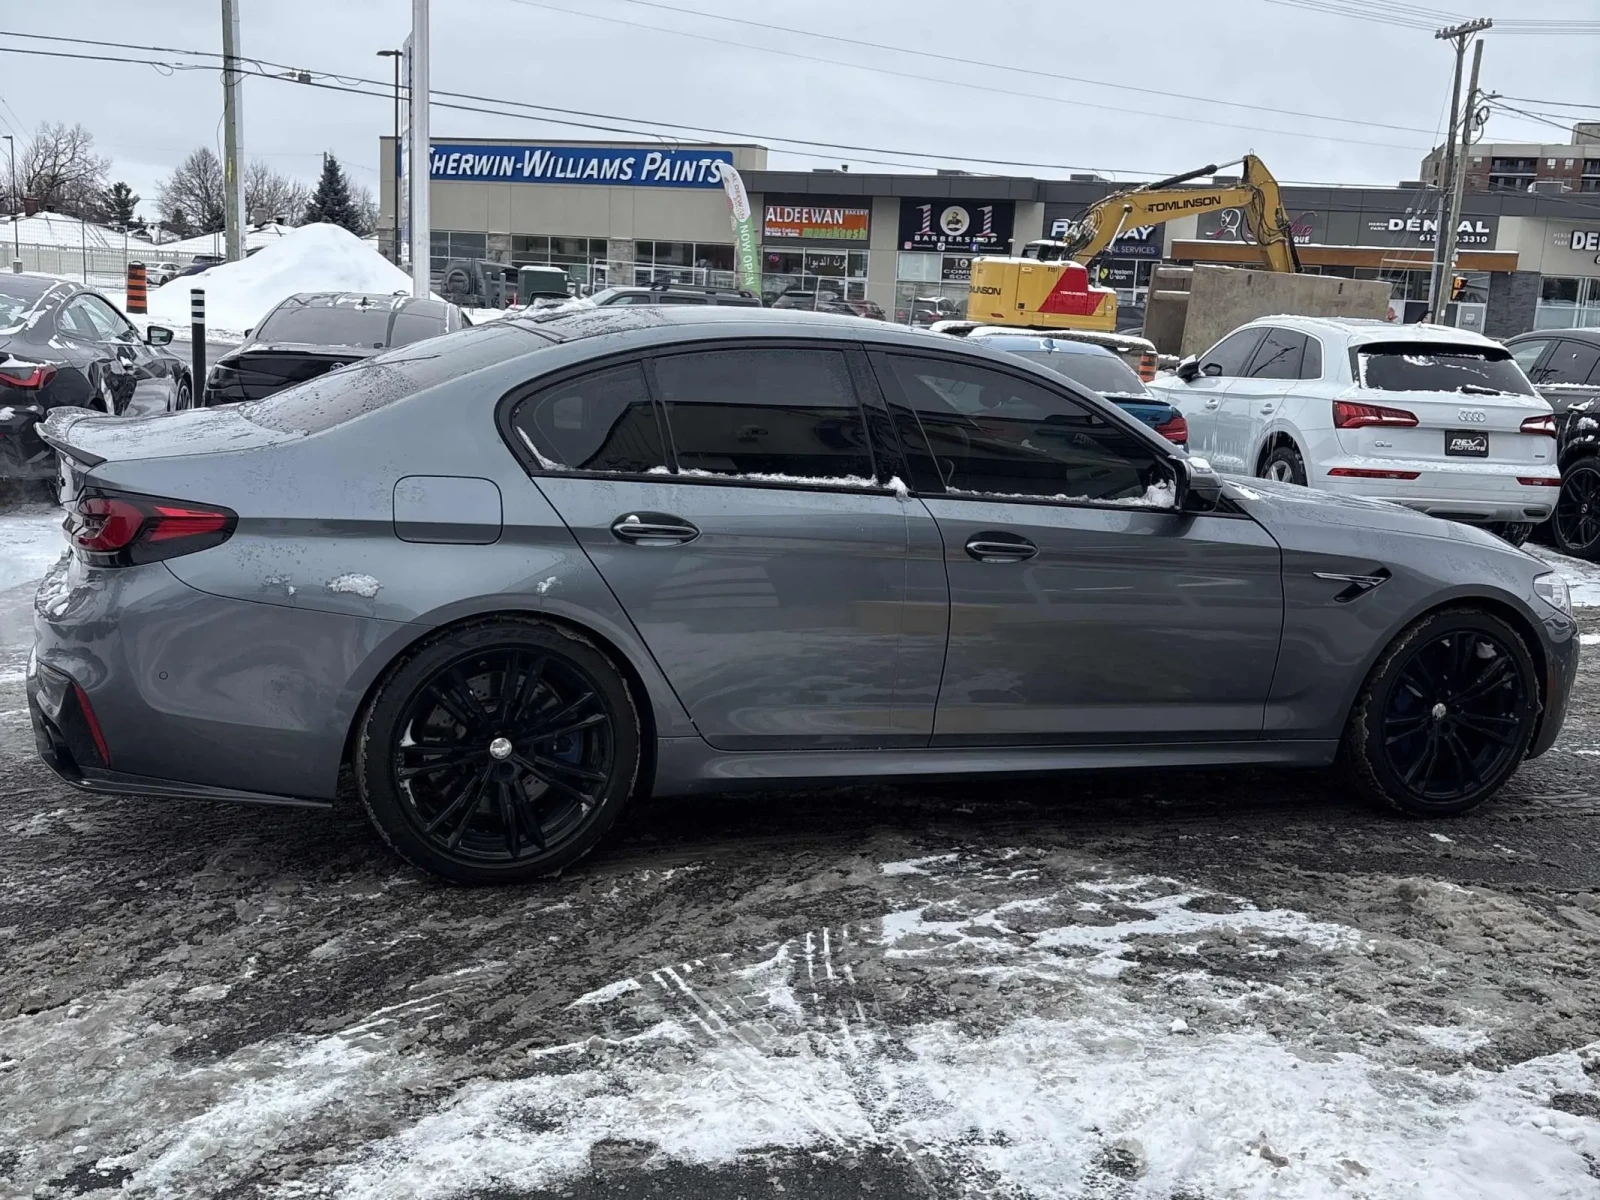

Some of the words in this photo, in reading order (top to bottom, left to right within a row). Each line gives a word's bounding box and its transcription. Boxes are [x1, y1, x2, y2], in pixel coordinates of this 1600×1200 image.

[641, 152, 724, 183] PAINTS
[1150, 196, 1221, 213] TOMLINSON
[766, 207, 843, 224] ALDEEWAN
[802, 227, 867, 239] manakeesh
[1388, 218, 1490, 233] DENAL
[740, 224, 752, 252] NOW
[914, 235, 997, 243] BARBERSHOP
[1572, 231, 1600, 250] DE
[1121, 245, 1155, 254] SERVICES
[743, 255, 755, 285] OPEN
[1451, 438, 1481, 446] REV
